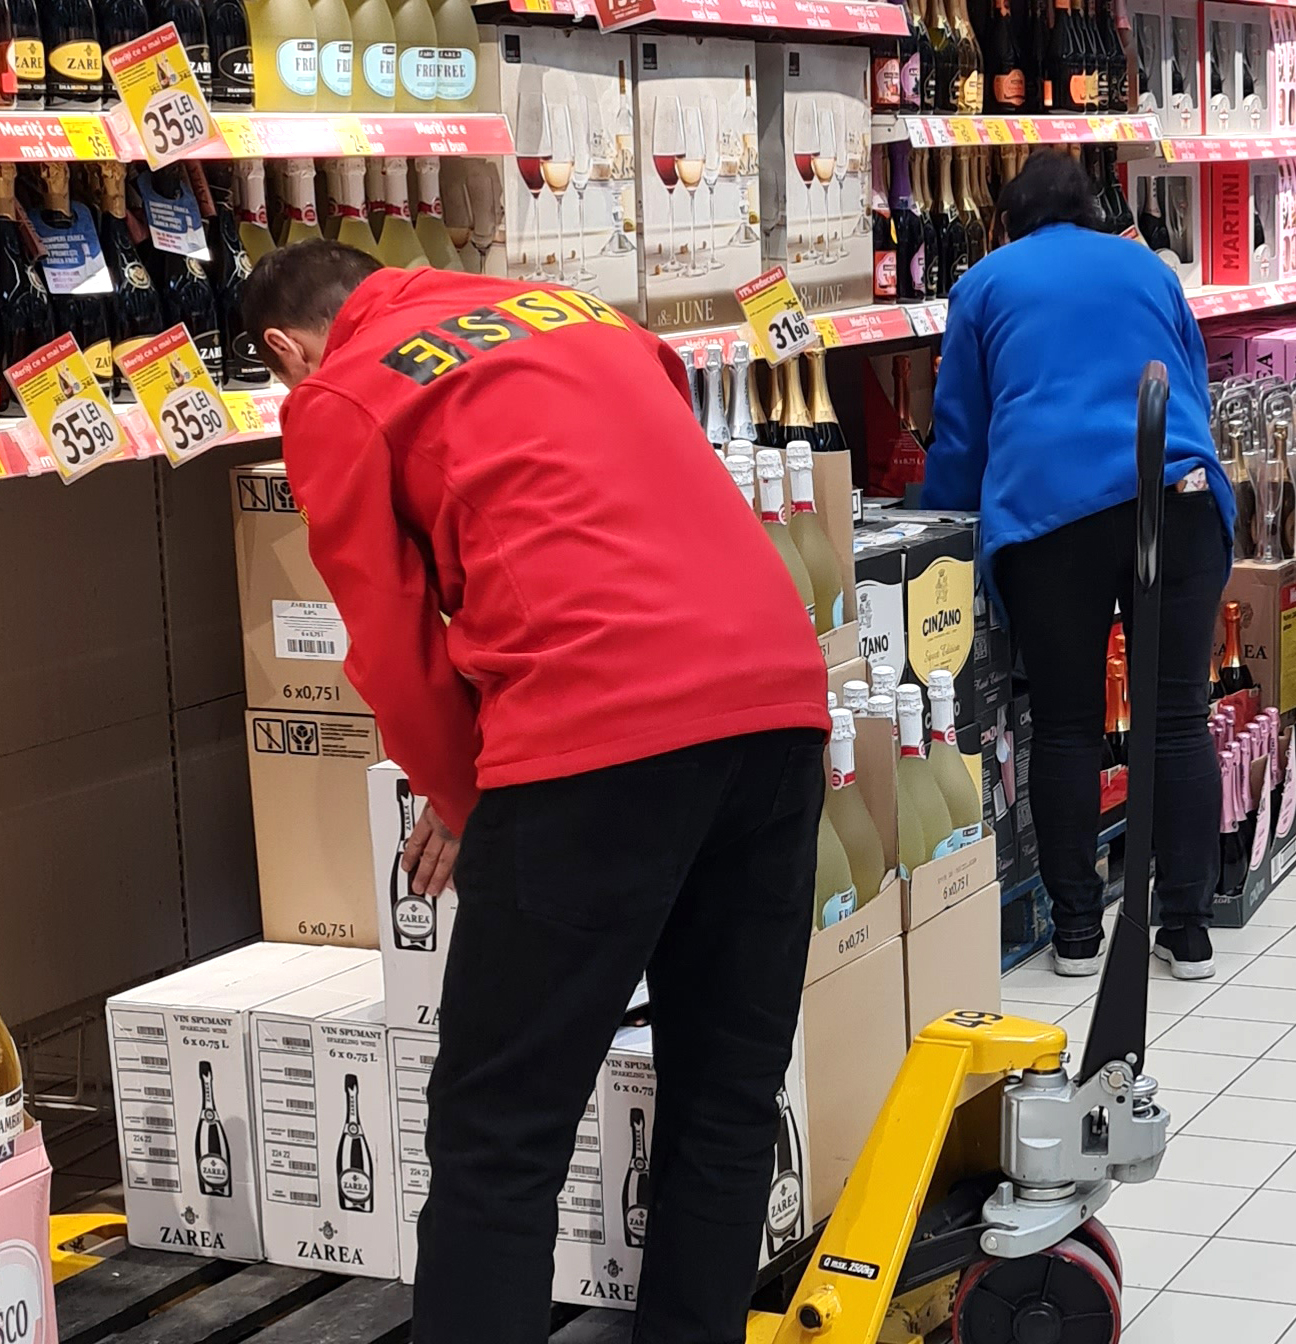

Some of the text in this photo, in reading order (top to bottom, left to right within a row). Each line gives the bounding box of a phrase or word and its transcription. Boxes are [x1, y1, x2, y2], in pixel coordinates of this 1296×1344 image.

[176, 94, 193, 115] LEI
[1, 122, 63, 137] Meriți ce
[144, 102, 184, 154] 35
[183, 114, 204, 138] 90
[416, 122, 446, 138] Meriți
[447, 123, 458, 135] ce
[20, 142, 47, 157] mai
[430, 140, 448, 153] mai
[1222, 173, 1240, 270] MARTINI
[816, 284, 842, 307] JUNE
[674, 299, 714, 324] JUNE
[793, 311, 804, 323] LEI
[769, 316, 797, 349] 31
[794, 321, 810, 337] 90
[193, 389, 210, 412] LEI
[83, 401, 101, 423] LEI
[162, 402, 202, 449] 35
[202, 409, 222, 433] 90
[52, 412, 95, 464] 35
[93, 421, 114, 446] 90
[922, 608, 962, 636] CINZANO
[283, 684, 292, 698] 6
[399, 913, 430, 924] ZAREA
[298, 921, 307, 935] 6
[173, 1015, 233, 1026] VIN SPUMANT
[943, 1011, 1004, 1028] 49
[180, 1025, 210, 1034] SPARKLING
[321, 1026, 382, 1040] VIN SPUMANT
[199, 1039, 220, 1049] 0.75
[327, 1037, 356, 1046] SPARKLING
[347, 1052, 369, 1063] 0.75
[606, 1058, 622, 1069] VIN
[632, 1084, 654, 1097] 0.75
[202, 1166, 226, 1177] ZAREA
[343, 1182, 368, 1193] ZAREA
[770, 1191, 799, 1218] ZAREA
[160, 1226, 226, 1249] ZAREA
[297, 1240, 365, 1266] ZAREA
[580, 1279, 636, 1303] ZARE
